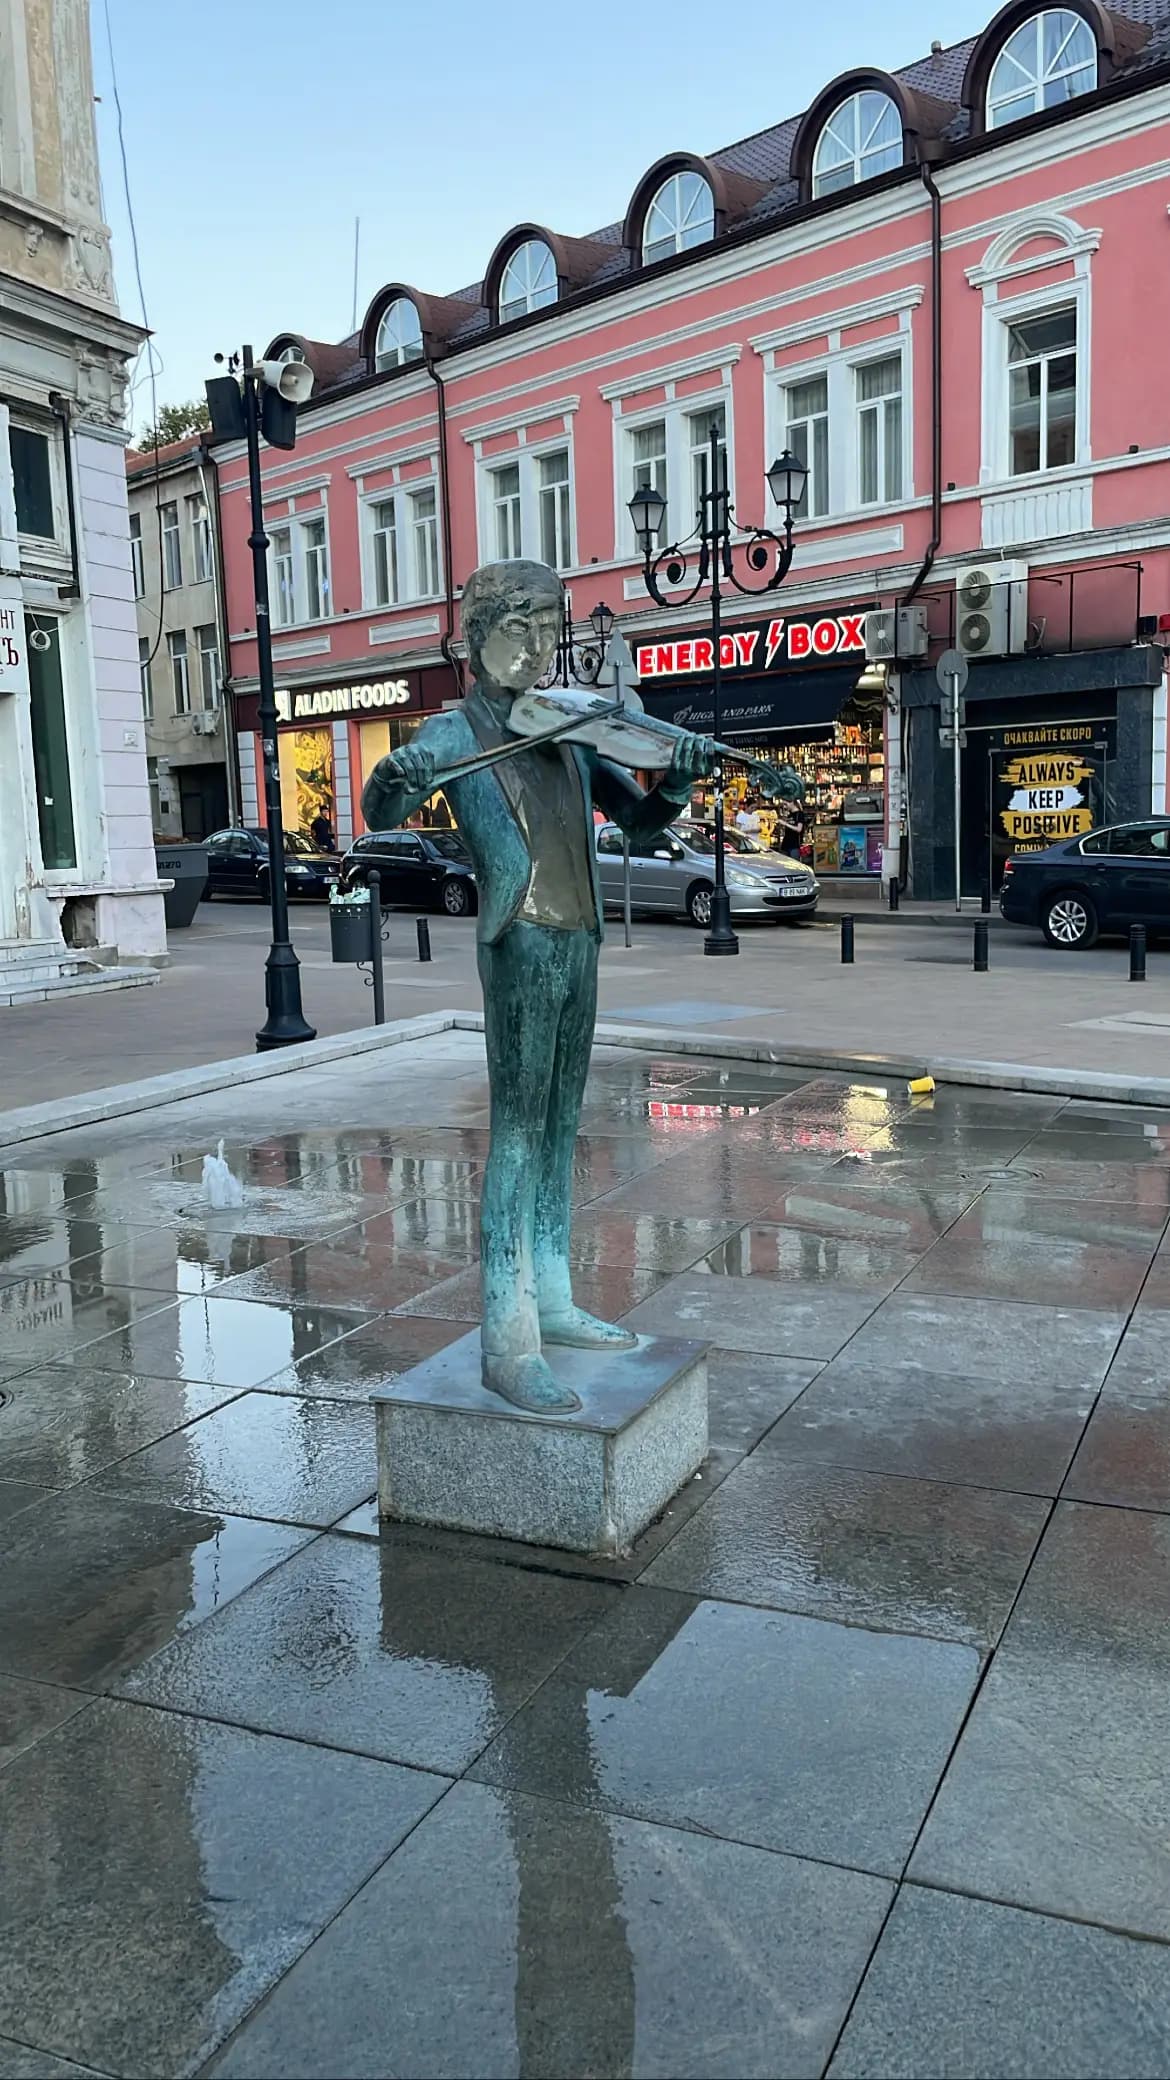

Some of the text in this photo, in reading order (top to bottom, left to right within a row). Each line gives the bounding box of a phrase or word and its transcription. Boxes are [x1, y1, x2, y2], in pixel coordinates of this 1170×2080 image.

[637, 614, 866, 678] ENERGY BOX
[294, 680, 410, 717] ALADIN FOODS
[1004, 727, 1092, 745] ОЧАКВАЙТЕ СКОРО
[1019, 761, 1075, 783] ALWAYS
[1028, 790, 1064, 809] KEEP
[1013, 814, 1080, 834] POSITIVE
